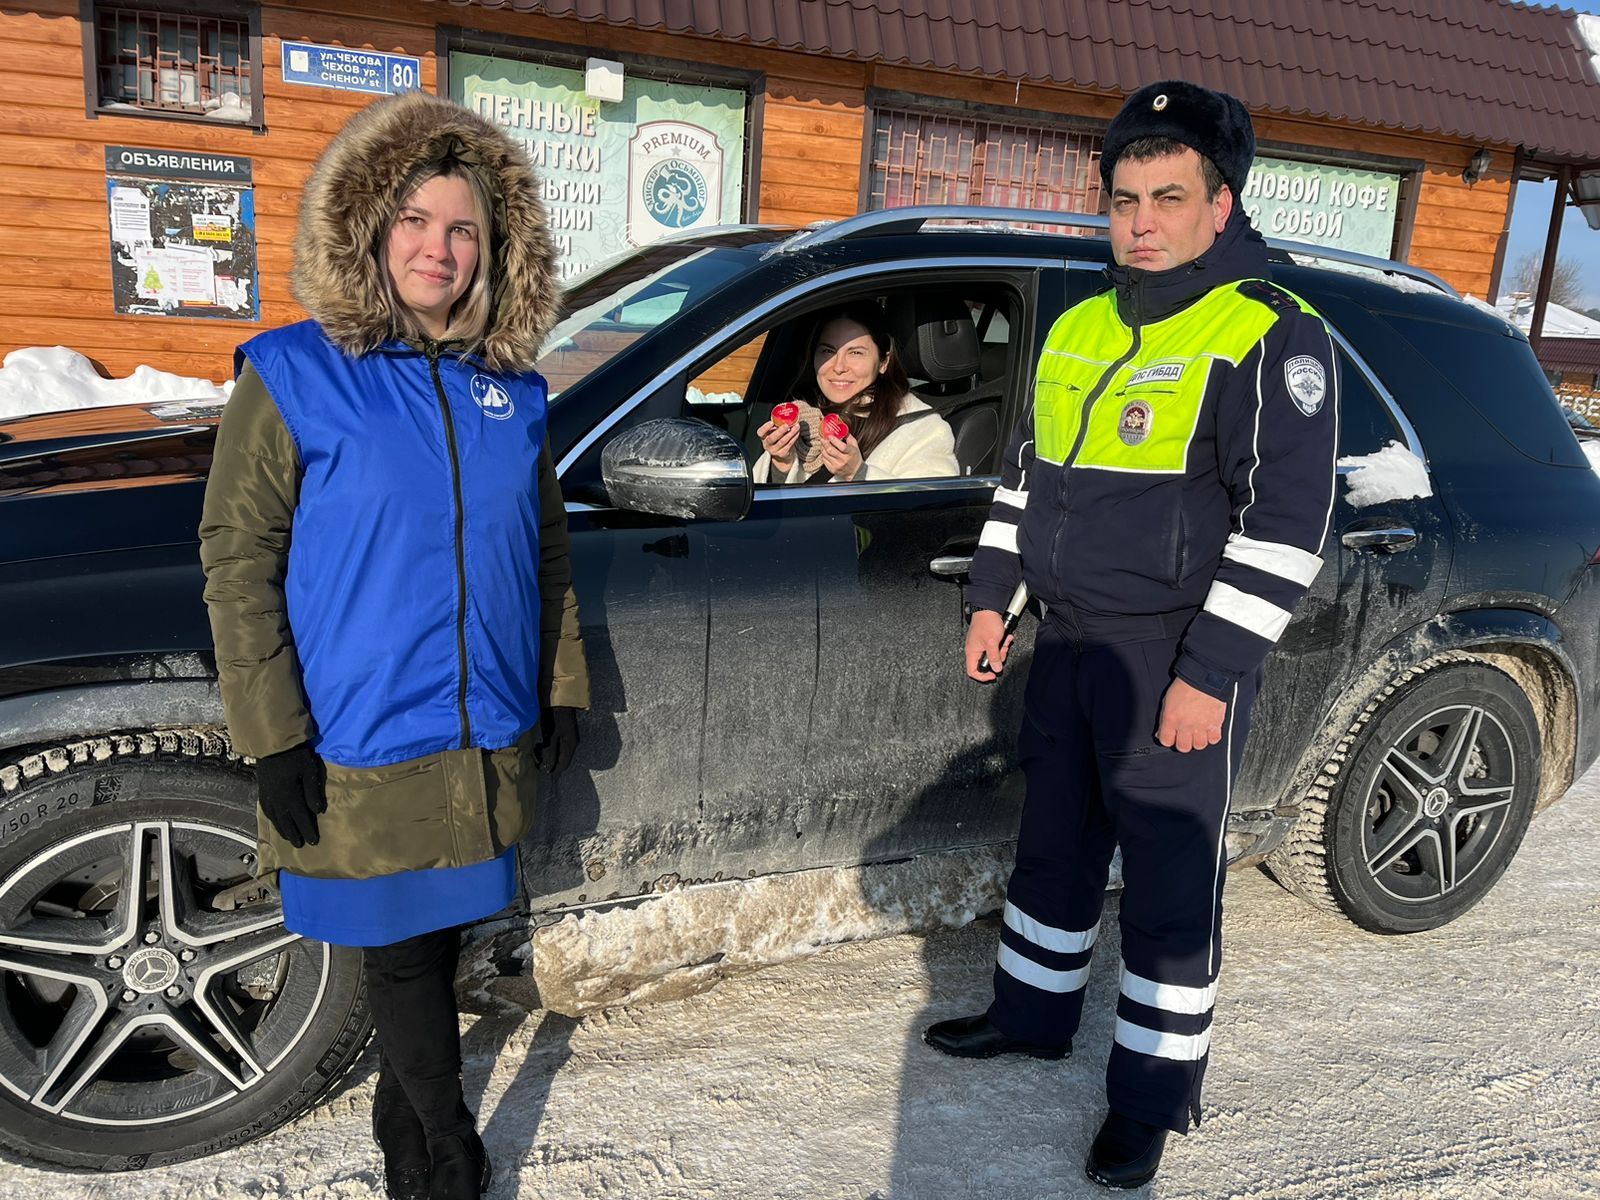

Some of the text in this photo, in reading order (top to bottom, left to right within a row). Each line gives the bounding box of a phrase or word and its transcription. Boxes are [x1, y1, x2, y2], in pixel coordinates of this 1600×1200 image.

[320, 52, 382, 67] ул.ЧЕХОВА
[322, 62, 360, 74] ЧЕХОВ
[321, 72, 380, 87] CHEHOV st
[392, 63, 413, 88] 80
[474, 92, 597, 138] ПЕННЫЕ
[520, 138, 601, 173] ИТКИ
[642, 132, 711, 160] PREMIUM
[120, 151, 235, 174] ОБЪЯВЛЕНИЯ
[1245, 169, 1390, 211] НОВОЙ КОФЕ
[1271, 206, 1344, 239] СОБОЙ
[1147, 366, 1180, 378] ГИБДД
[37, 803, 48, 818] R
[56, 792, 79, 811] 20
